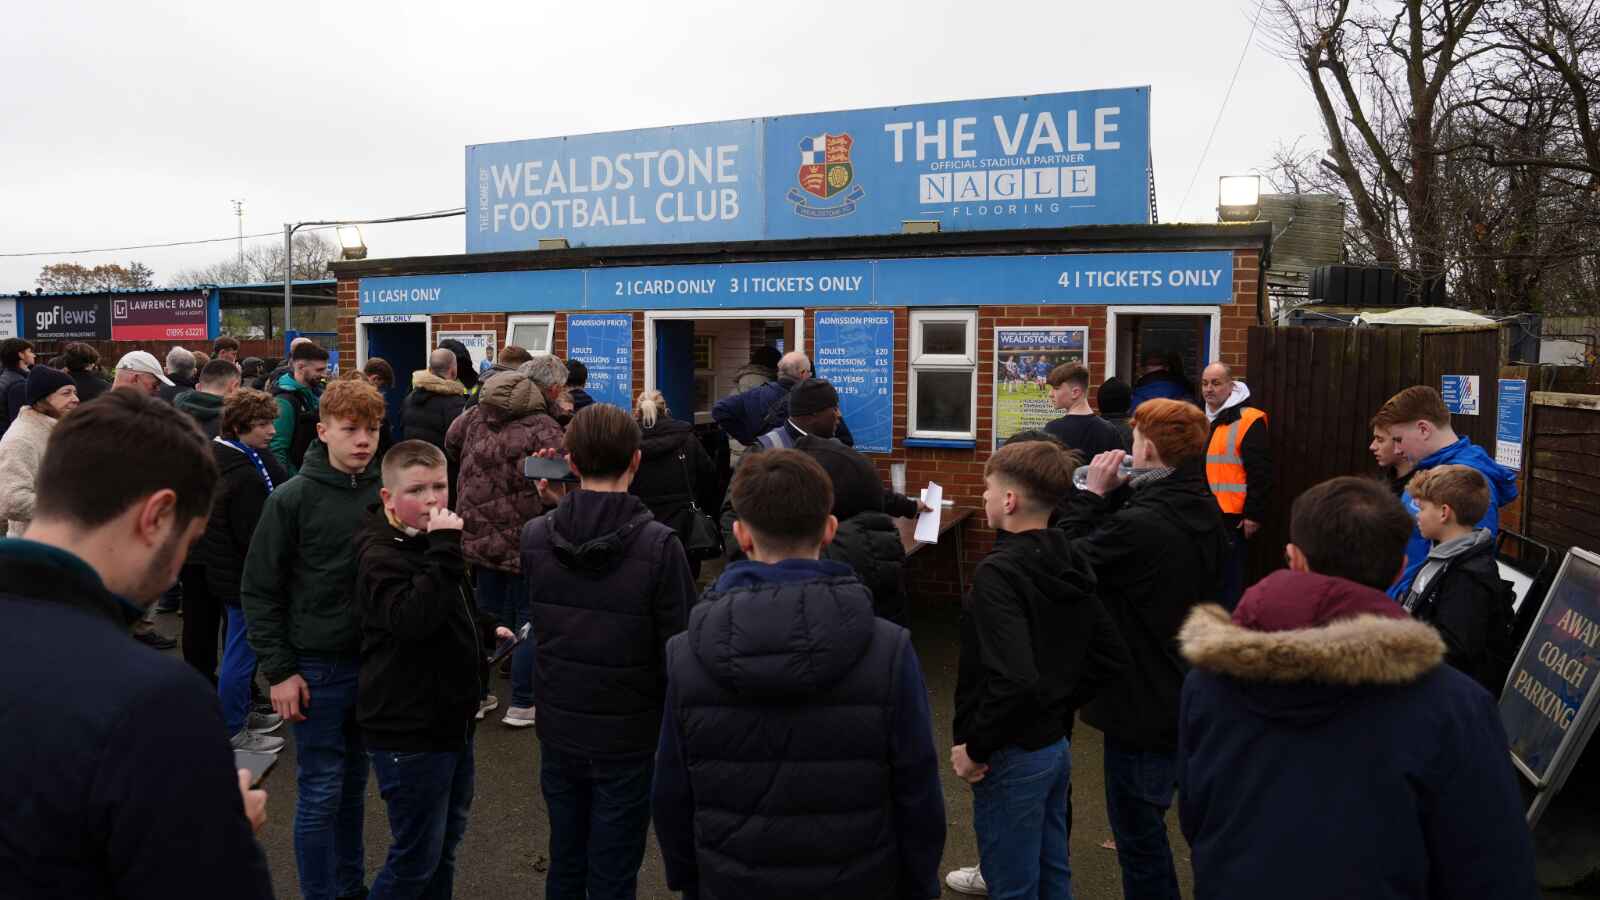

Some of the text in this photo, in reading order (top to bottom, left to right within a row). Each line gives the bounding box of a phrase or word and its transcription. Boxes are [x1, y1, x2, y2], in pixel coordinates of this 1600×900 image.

[884, 106, 1121, 162] THE VALE
[930, 153, 1085, 171] OFFICIAL STADIUM PARTNER
[490, 144, 739, 199] WEALDSTONE
[923, 168, 1092, 201] NAGLE
[479, 168, 489, 232] THE HOME OF
[493, 188, 740, 233] FOOTBALL CLUB
[952, 204, 1061, 217] FLOORING
[730, 278, 739, 293] 3
[752, 277, 814, 293] TICKETS
[819, 276, 862, 292] ONLY
[1058, 271, 1070, 288] 4
[1085, 270, 1163, 288] TICKETS
[1168, 269, 1222, 287] ONLY
[363, 291, 369, 303] 1
[378, 288, 408, 303] CASH
[411, 287, 441, 302] ONLY
[615, 282, 624, 296] 2
[634, 280, 674, 295] CARD
[677, 279, 717, 294] ONLY
[130, 298, 204, 310] LAWRENCE RAND
[571, 319, 628, 327] ADMISSION PRICES
[819, 316, 889, 325] ADMISSION PRICES
[1000, 335, 1069, 344] WEALDSTONE FC
[819, 358, 866, 366] CONCESSIONS
[843, 375, 865, 383] YEARS
[1557, 608, 1600, 650] AWAY
[1537, 641, 1589, 688] COACH
[1514, 670, 1576, 732] PARKING
